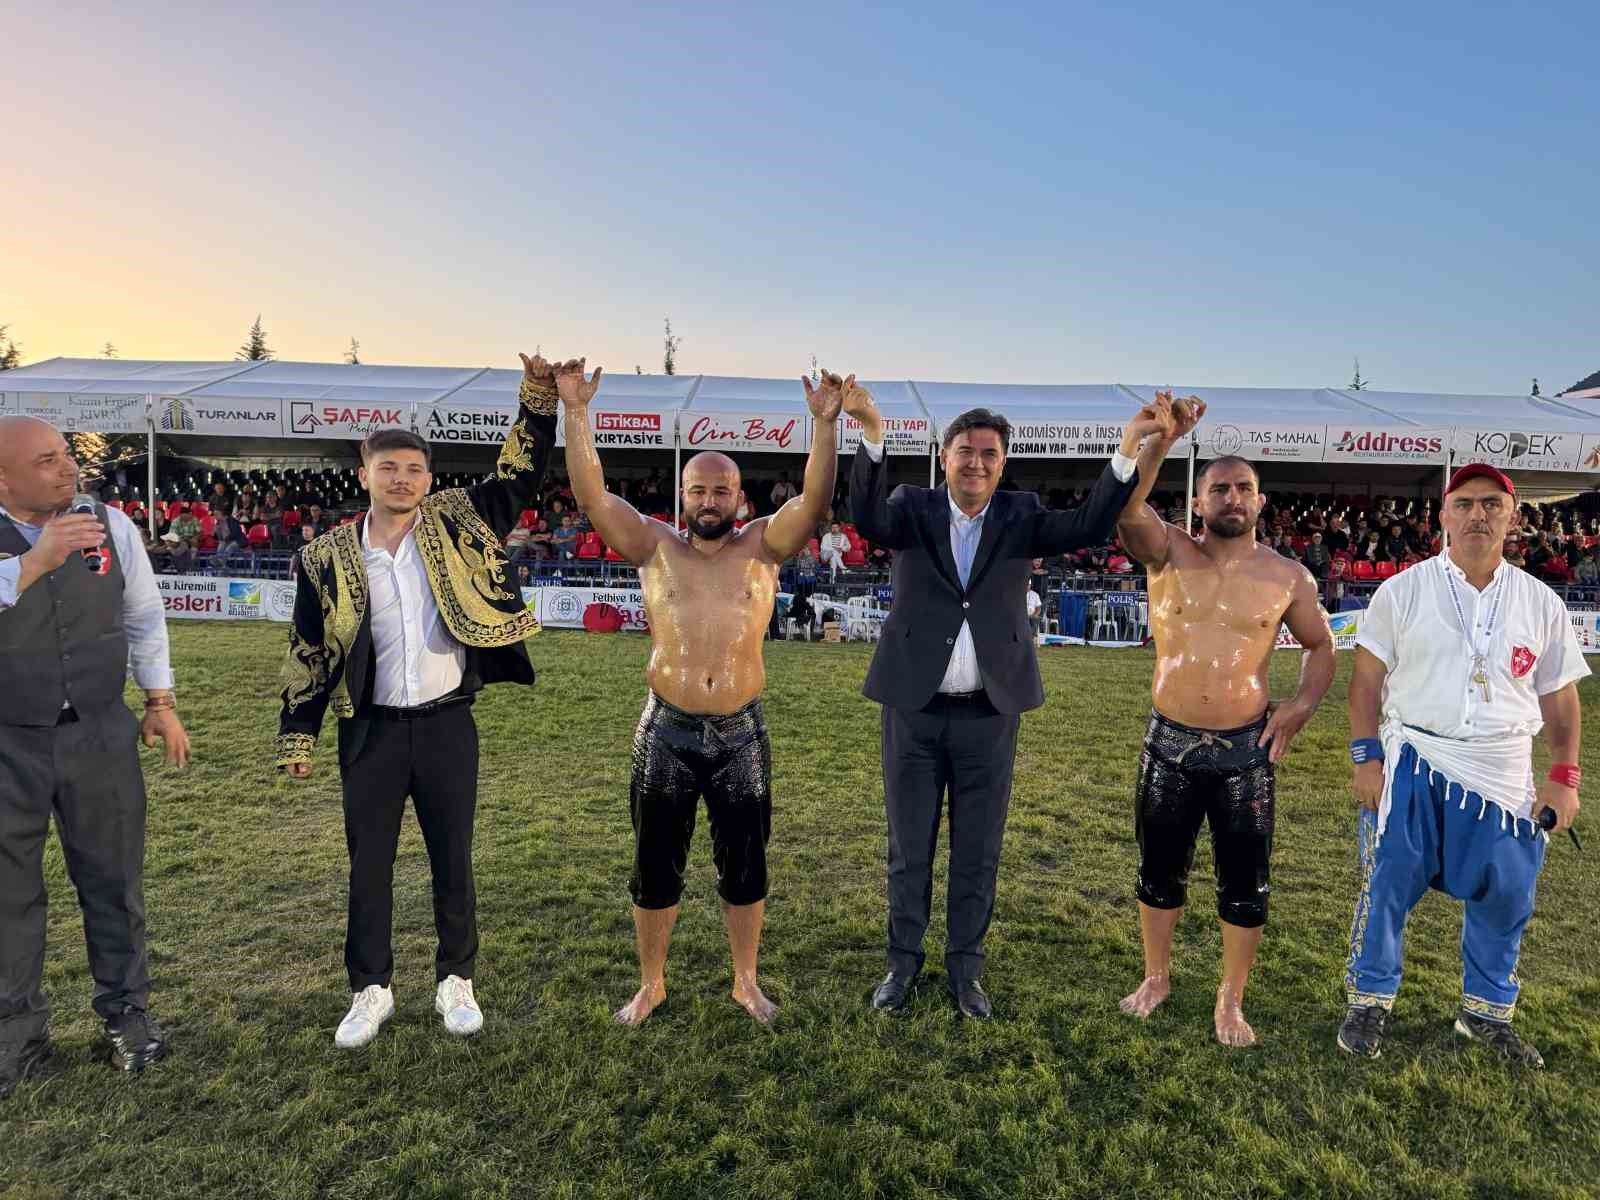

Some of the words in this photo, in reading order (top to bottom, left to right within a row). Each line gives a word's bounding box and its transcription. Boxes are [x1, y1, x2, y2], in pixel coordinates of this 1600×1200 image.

[196, 409, 276, 421] TURANLAR
[323, 408, 402, 424] ŞAFAK
[902, 420, 928, 431] YAPI
[1019, 424, 1080, 439] KOMİSYON
[1083, 426, 1092, 438] &
[430, 428, 506, 441] MOBİLYA
[594, 432, 663, 444] KIRTASİYE
[688, 417, 738, 445] Cin
[742, 418, 797, 448] Bal
[1276, 432, 1321, 445] MAHAL
[1011, 442, 1046, 454] OSMAN
[1049, 442, 1067, 454] YAR
[1077, 443, 1105, 454] ONUR
[1336, 431, 1443, 453] Address
[1459, 457, 1570, 470] CONSTRUCTION
[592, 592, 626, 603] Fethiye
